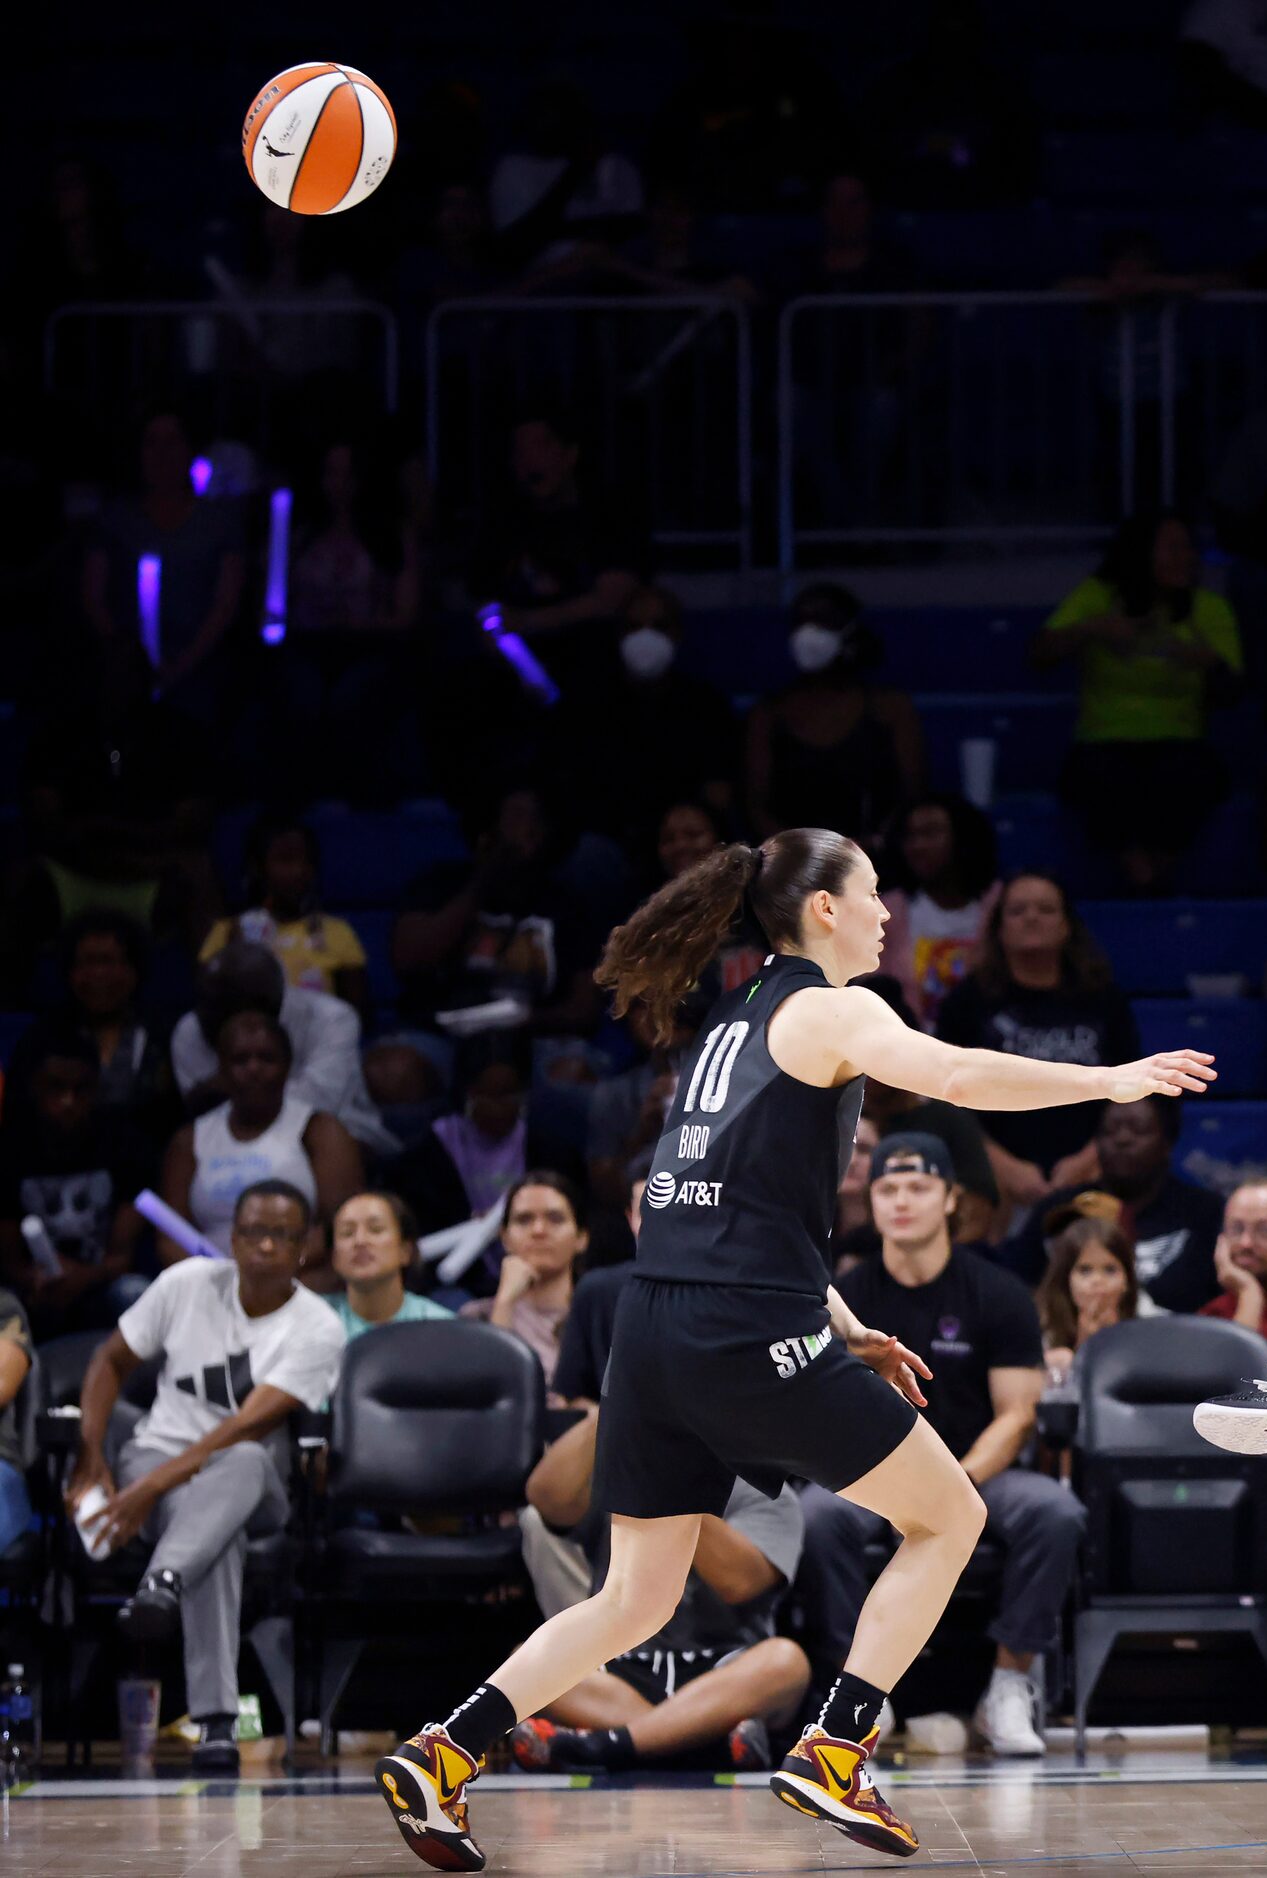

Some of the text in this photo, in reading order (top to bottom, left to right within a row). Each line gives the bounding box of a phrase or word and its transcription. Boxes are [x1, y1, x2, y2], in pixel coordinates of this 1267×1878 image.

[683, 1020, 750, 1114] 10
[677, 1124, 710, 1160] BIRD
[674, 1180, 723, 1207] AT&T
